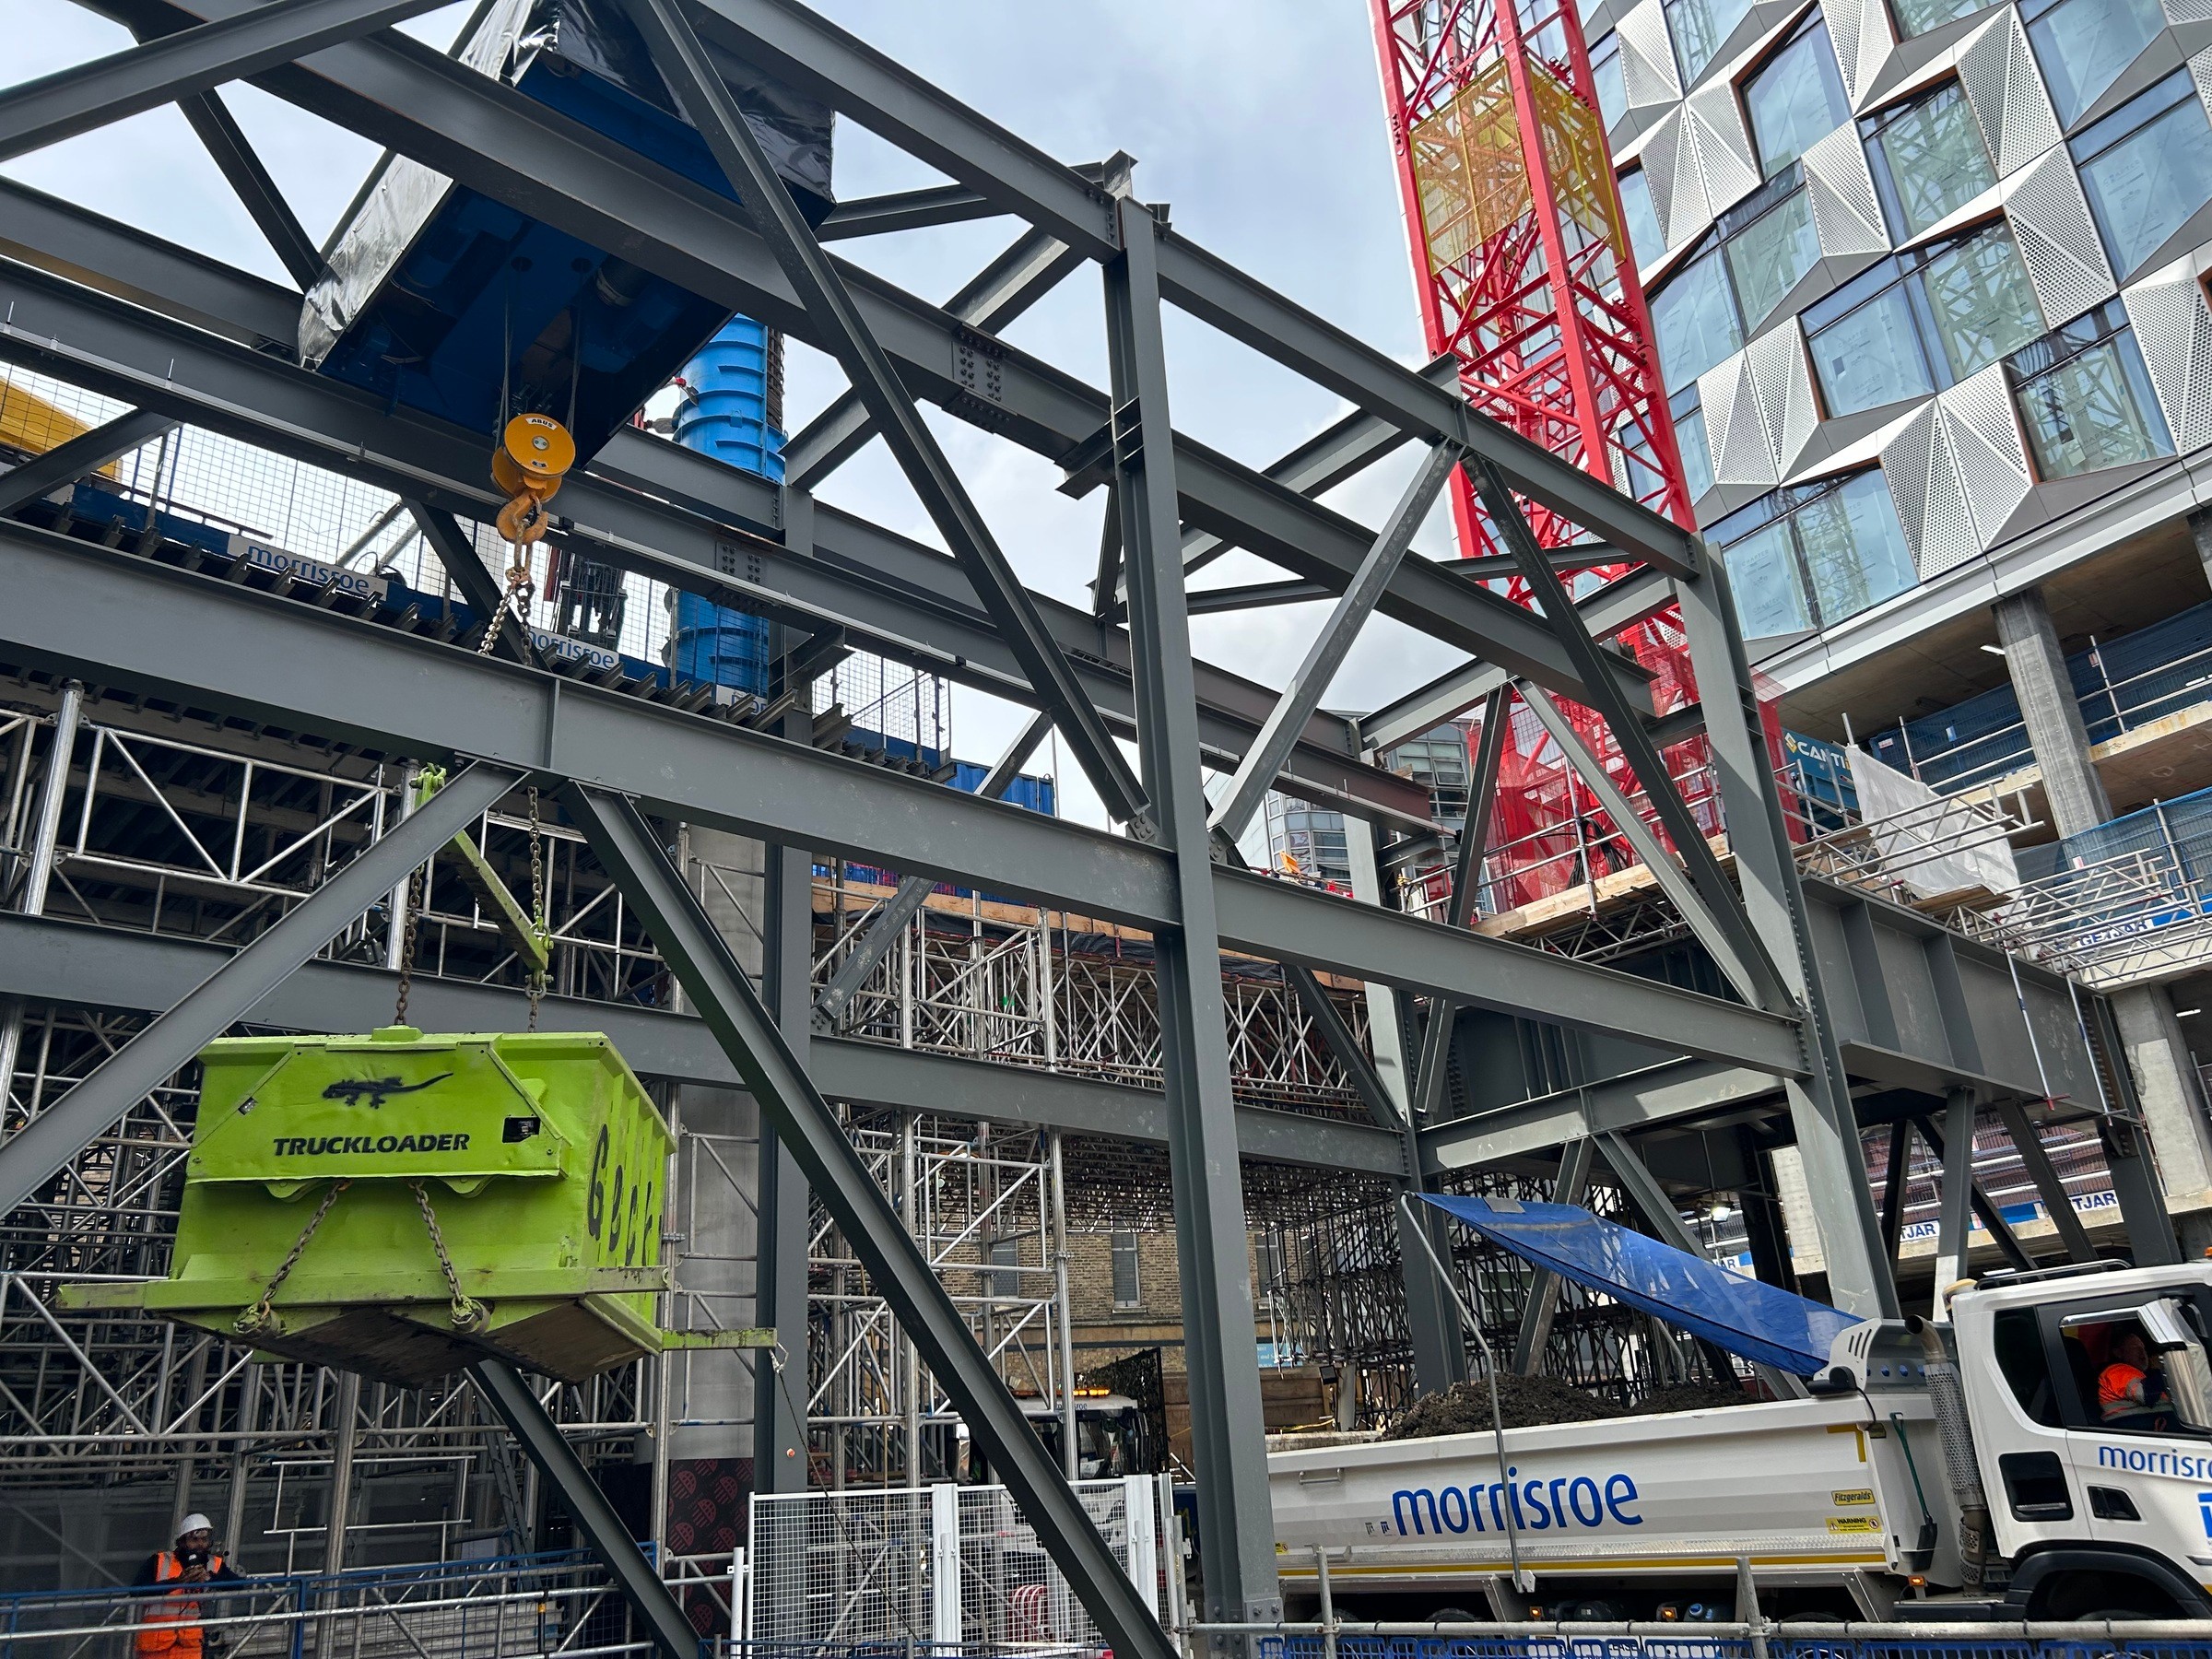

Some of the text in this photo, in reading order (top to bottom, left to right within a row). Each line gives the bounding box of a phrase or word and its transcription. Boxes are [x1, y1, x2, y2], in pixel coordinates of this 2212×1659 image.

[531, 418, 553, 428] ABUS
[248, 546, 369, 594] morrisroe
[273, 1133, 471, 1157] TRUCKLOADER
[587, 1123, 664, 1266] Geck
[1392, 1466, 1644, 1536] morrisroe
[1835, 1491, 1871, 1502] Fitzgeralds
